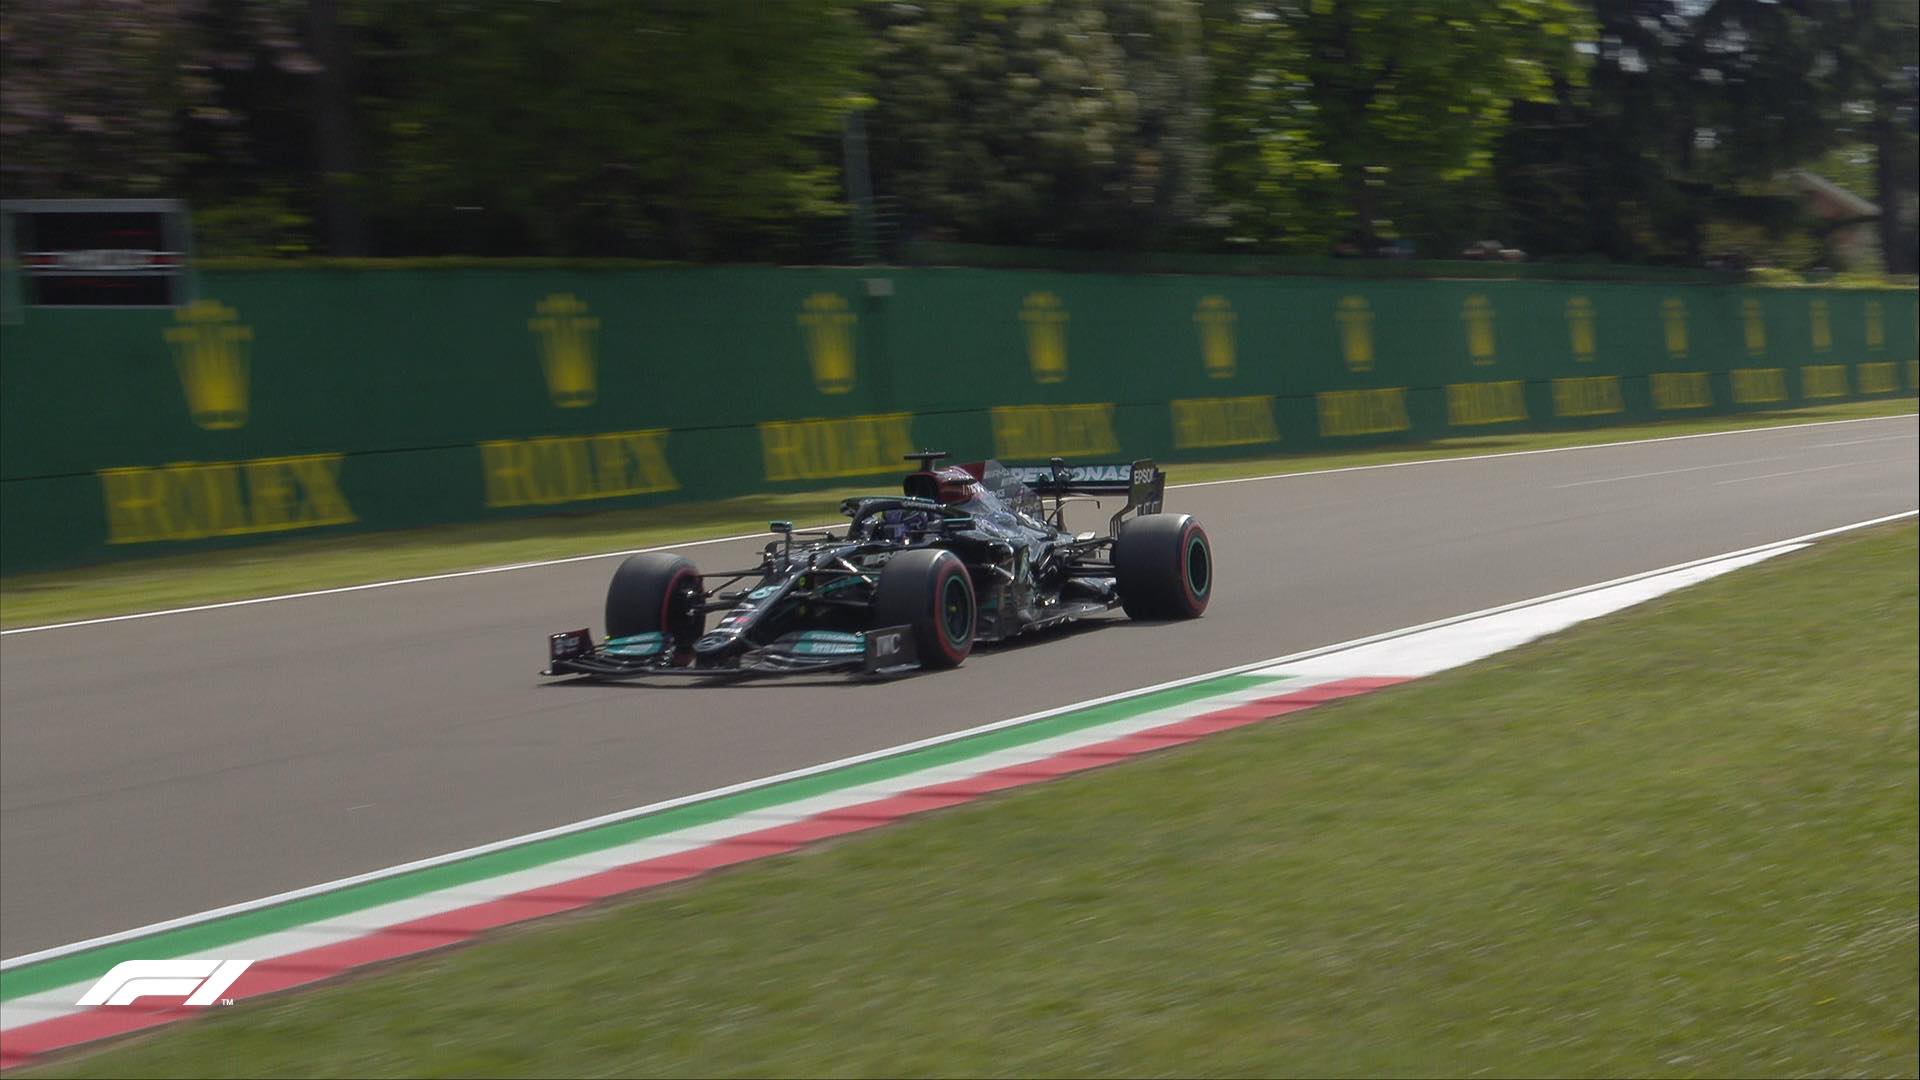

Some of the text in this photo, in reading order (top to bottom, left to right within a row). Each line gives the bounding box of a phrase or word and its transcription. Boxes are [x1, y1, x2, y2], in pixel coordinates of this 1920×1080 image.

[478, 427, 682, 508] ROLEX
[759, 411, 914, 482] ROLEX
[97, 452, 359, 545] ROLEX
